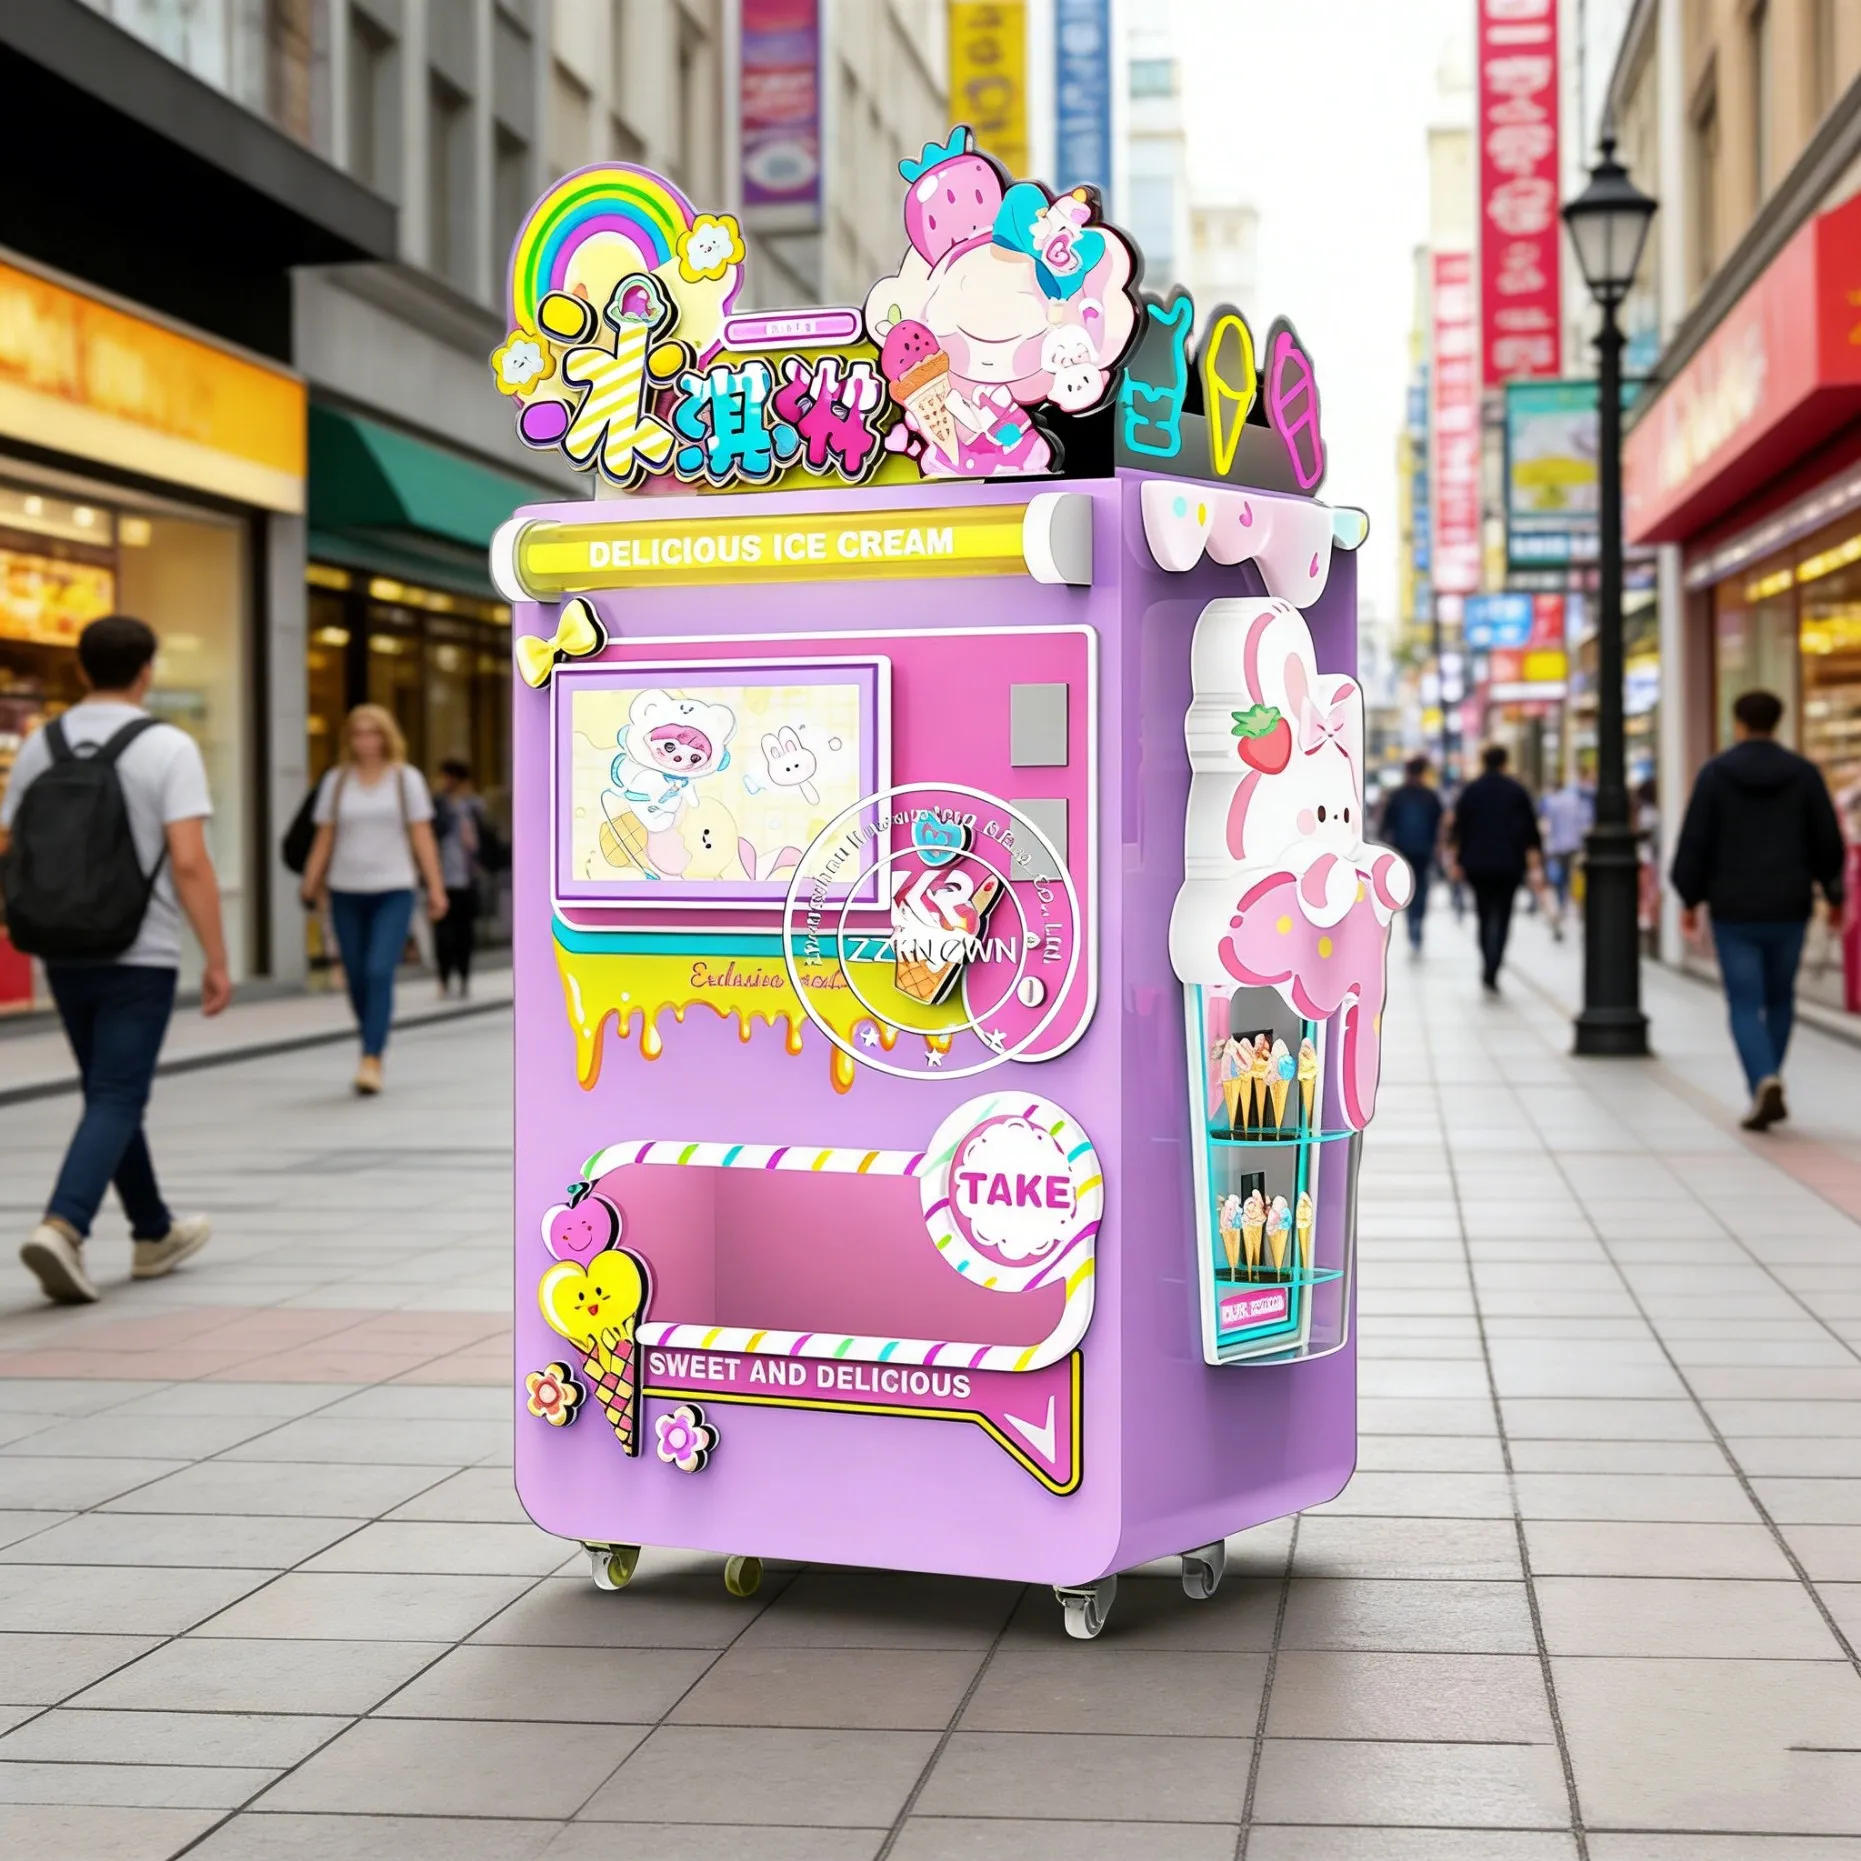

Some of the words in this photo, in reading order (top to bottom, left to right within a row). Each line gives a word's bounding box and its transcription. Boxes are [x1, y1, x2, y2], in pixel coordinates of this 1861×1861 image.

[588, 534, 762, 568] DELICIOUS
[773, 531, 826, 561] ICE
[837, 527, 954, 558] CREAM
[958, 1171, 1072, 1210] TAKE
[648, 1351, 741, 1382] SWEET
[749, 1359, 807, 1387] AND
[816, 1364, 972, 1399] DELICIOUS
